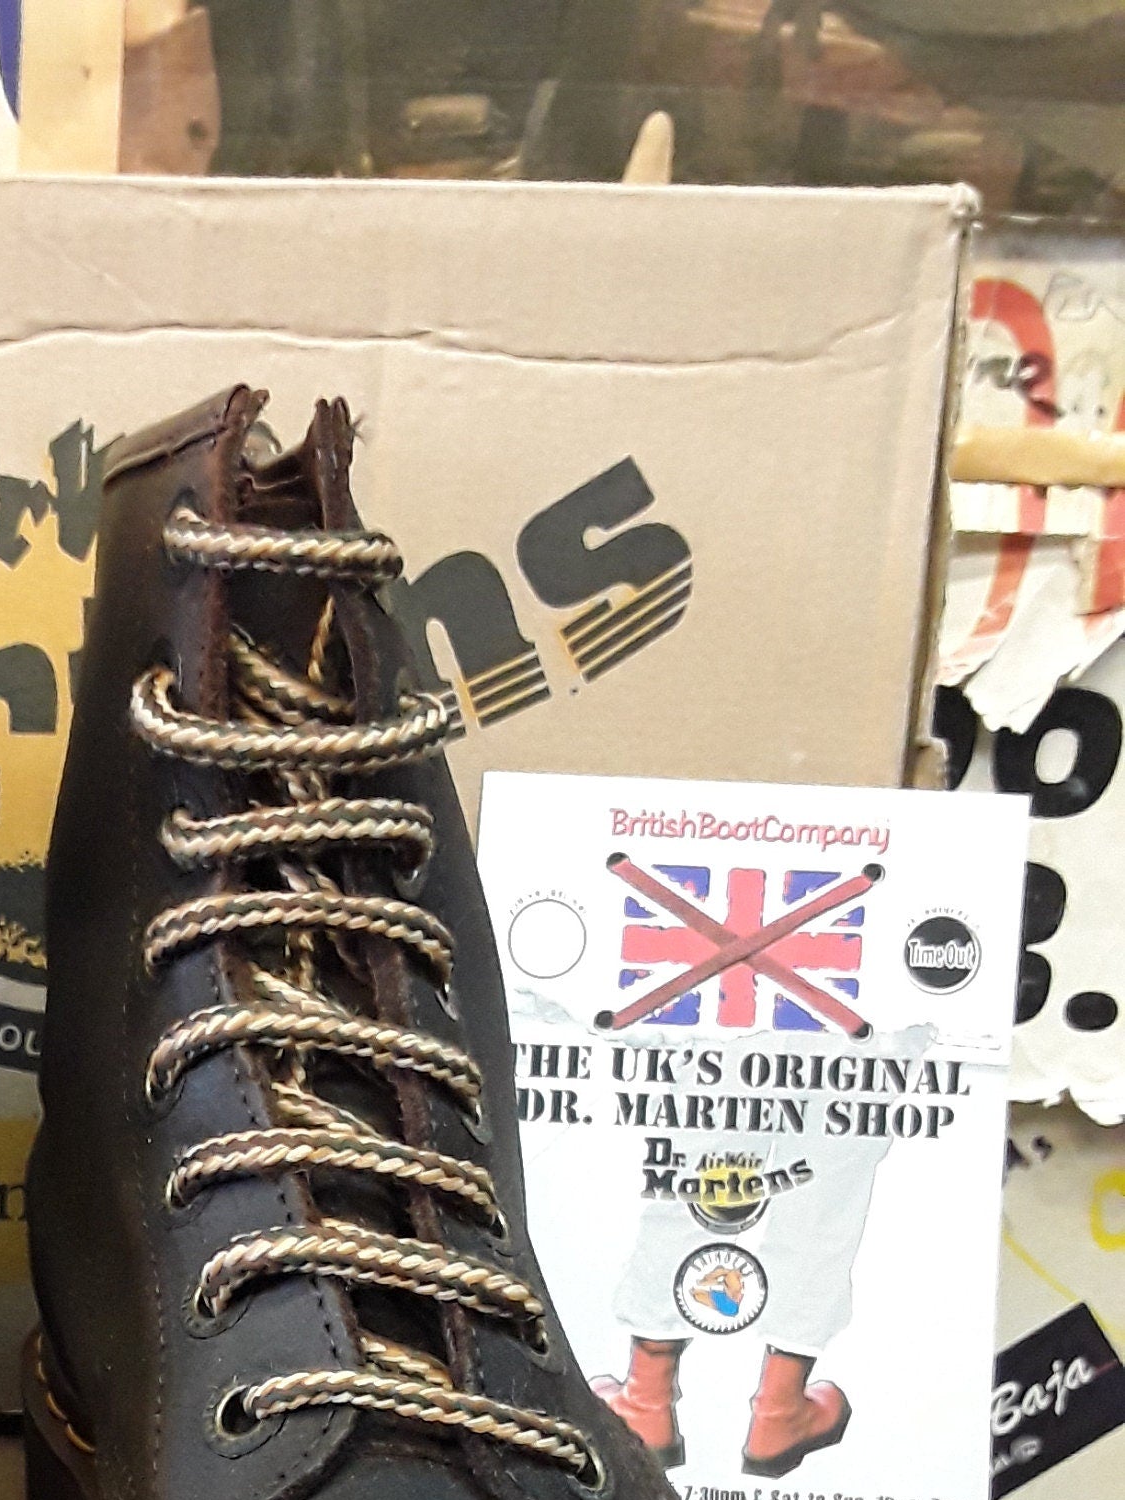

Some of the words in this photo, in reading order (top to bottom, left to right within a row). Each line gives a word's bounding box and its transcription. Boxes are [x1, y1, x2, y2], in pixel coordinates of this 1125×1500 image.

[610, 808, 890, 855] BritishBootCompany
[611, 1046, 723, 1087] UK'S
[739, 1051, 972, 1096] ORIGINAL
[517, 1087, 593, 1125] DR.
[614, 1092, 808, 1136] MARTEN
[824, 1101, 956, 1140] SHOP
[640, 1158, 815, 1201] Martens
